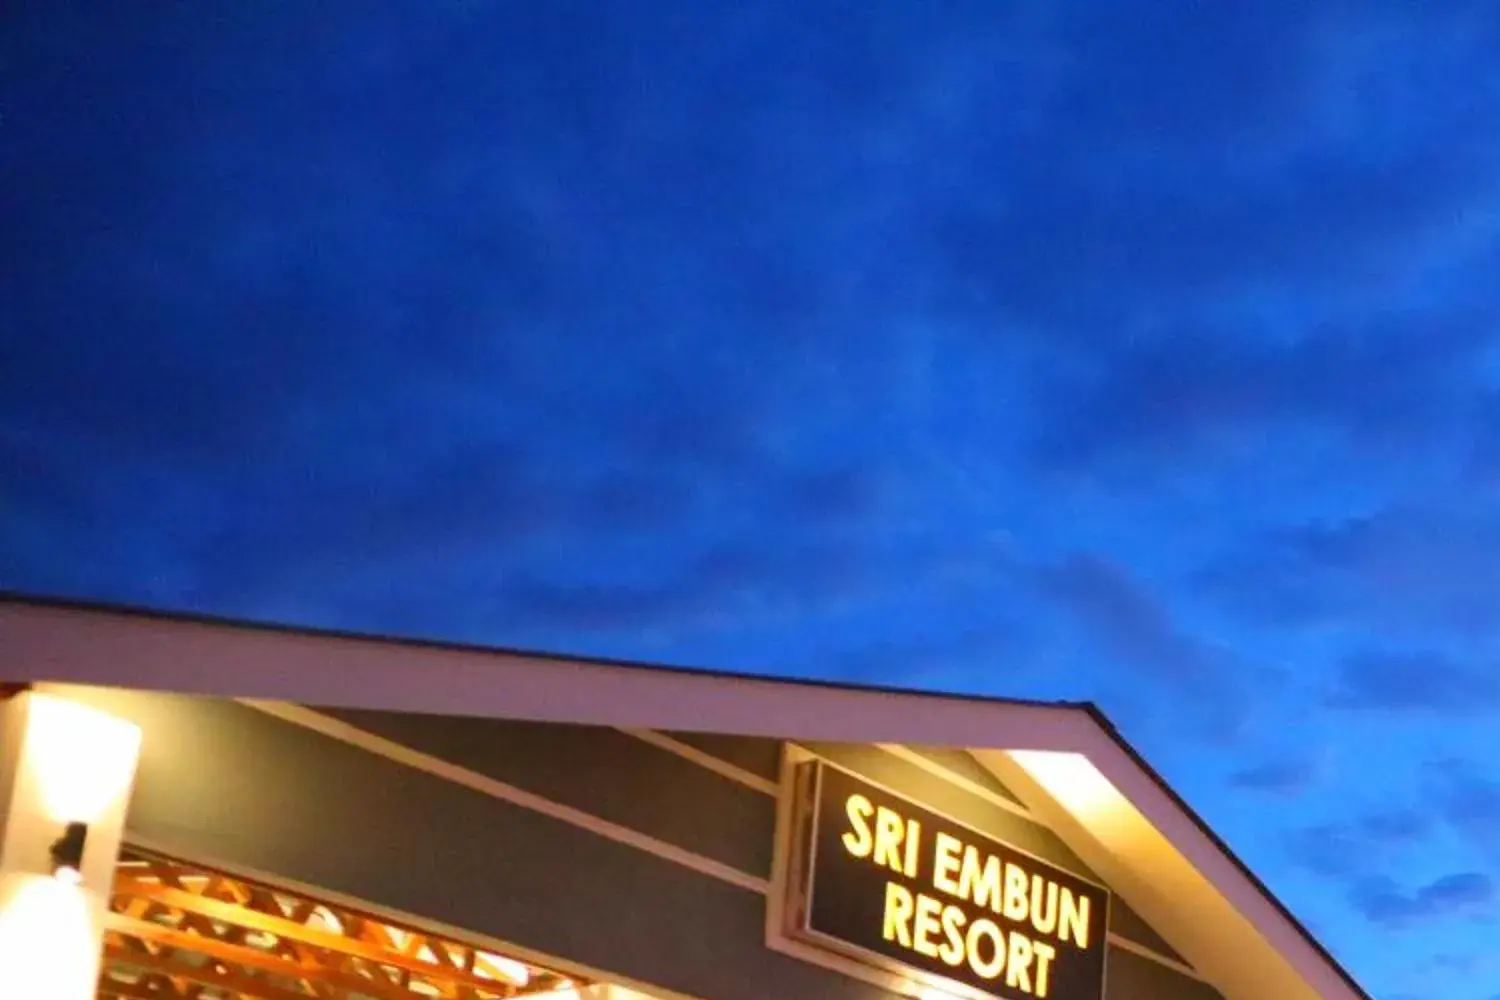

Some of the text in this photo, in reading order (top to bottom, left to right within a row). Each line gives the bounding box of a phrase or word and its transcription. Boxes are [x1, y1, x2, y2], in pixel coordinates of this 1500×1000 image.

[841, 794, 1091, 949] SRI EMBUN
[882, 881, 1056, 998] RESORT
